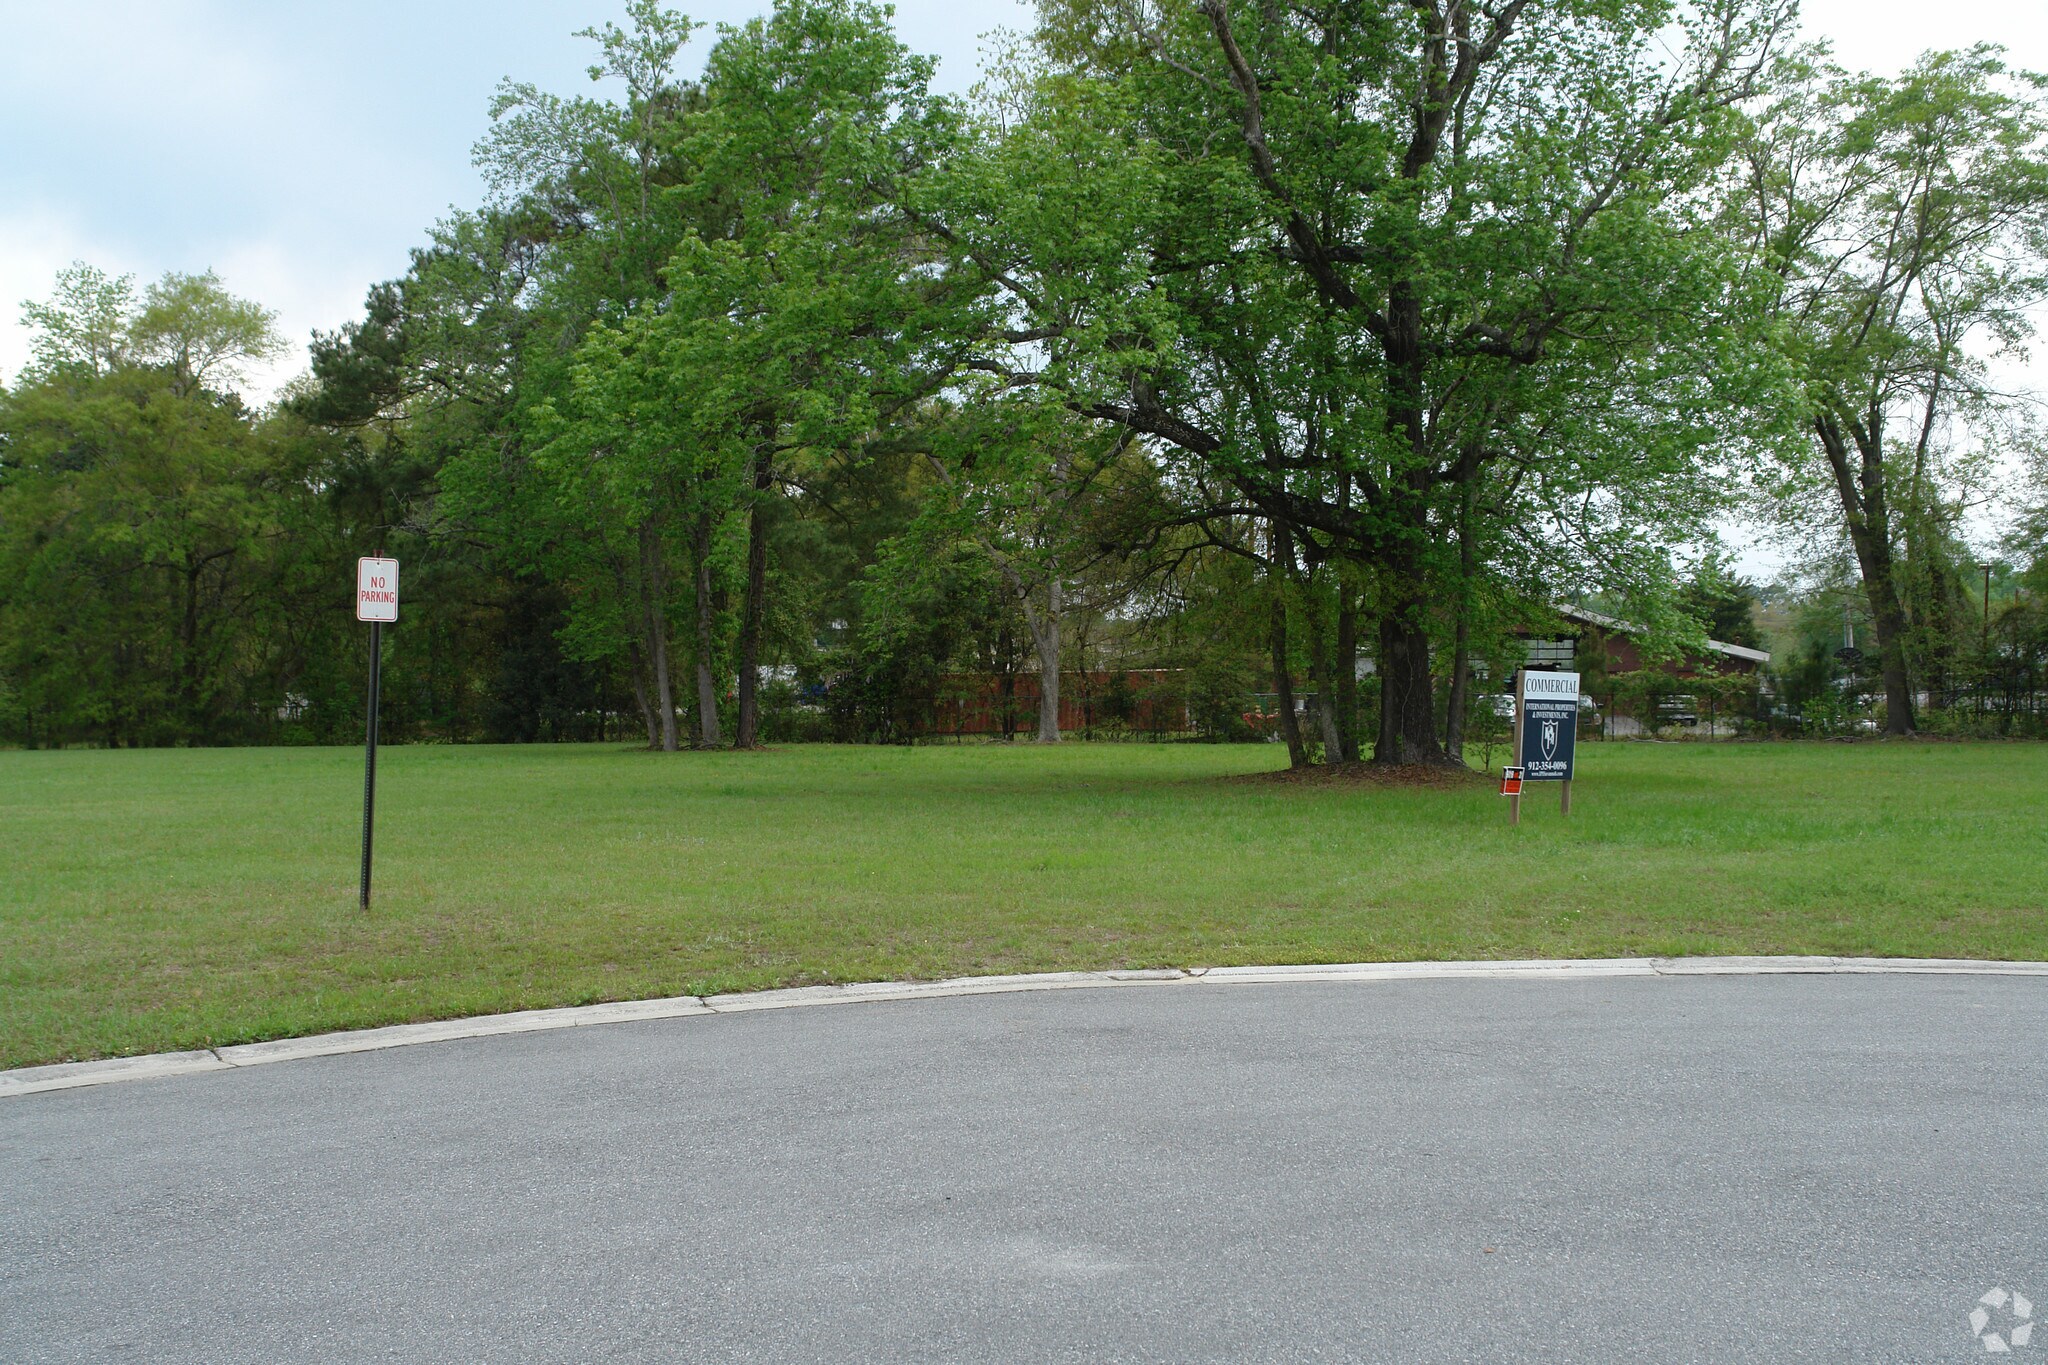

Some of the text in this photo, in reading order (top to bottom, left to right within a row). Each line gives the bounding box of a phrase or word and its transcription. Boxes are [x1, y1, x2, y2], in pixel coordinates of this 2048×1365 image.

[371, 577, 385, 588] NO
[361, 591, 395, 603] PARKING
[1526, 678, 1577, 693] COMMERCIAL
[1528, 761, 1567, 770] 912-354-0096
